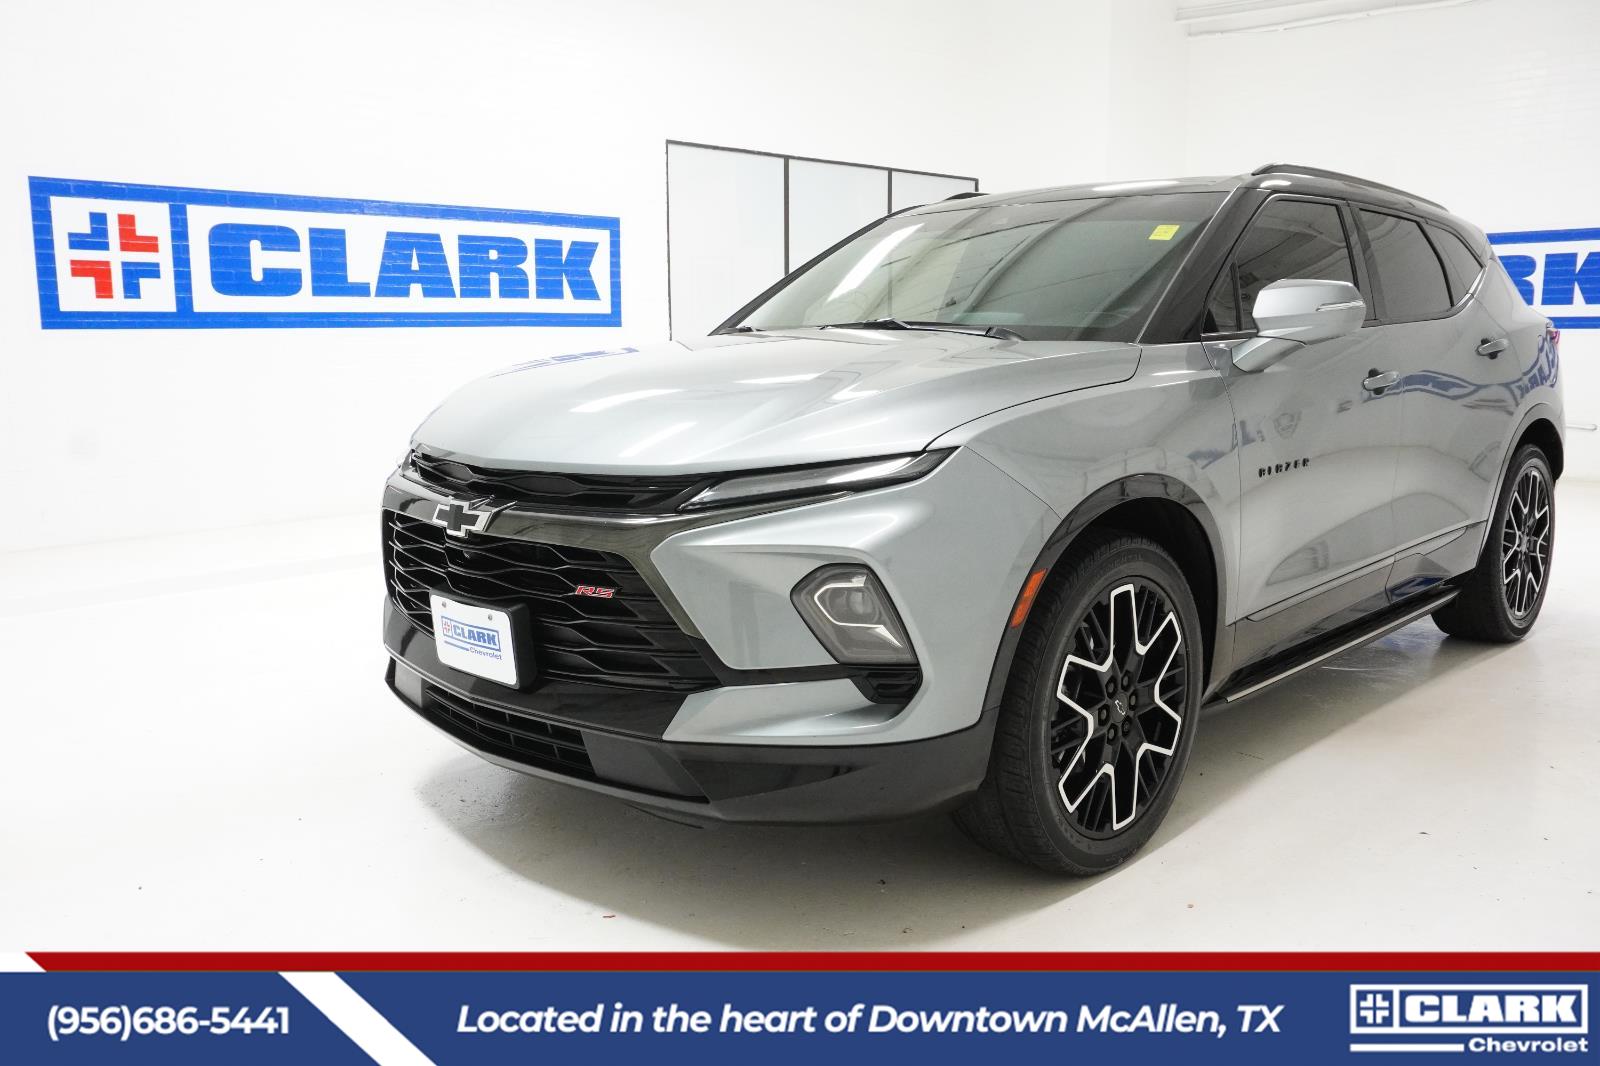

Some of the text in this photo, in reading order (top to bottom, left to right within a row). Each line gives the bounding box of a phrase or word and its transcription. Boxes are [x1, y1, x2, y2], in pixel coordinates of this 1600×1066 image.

[208, 223, 601, 301] CLARK
[574, 585, 615, 598] RS
[452, 625, 498, 647] CLARK
[469, 646, 502, 661] Chevrolet
